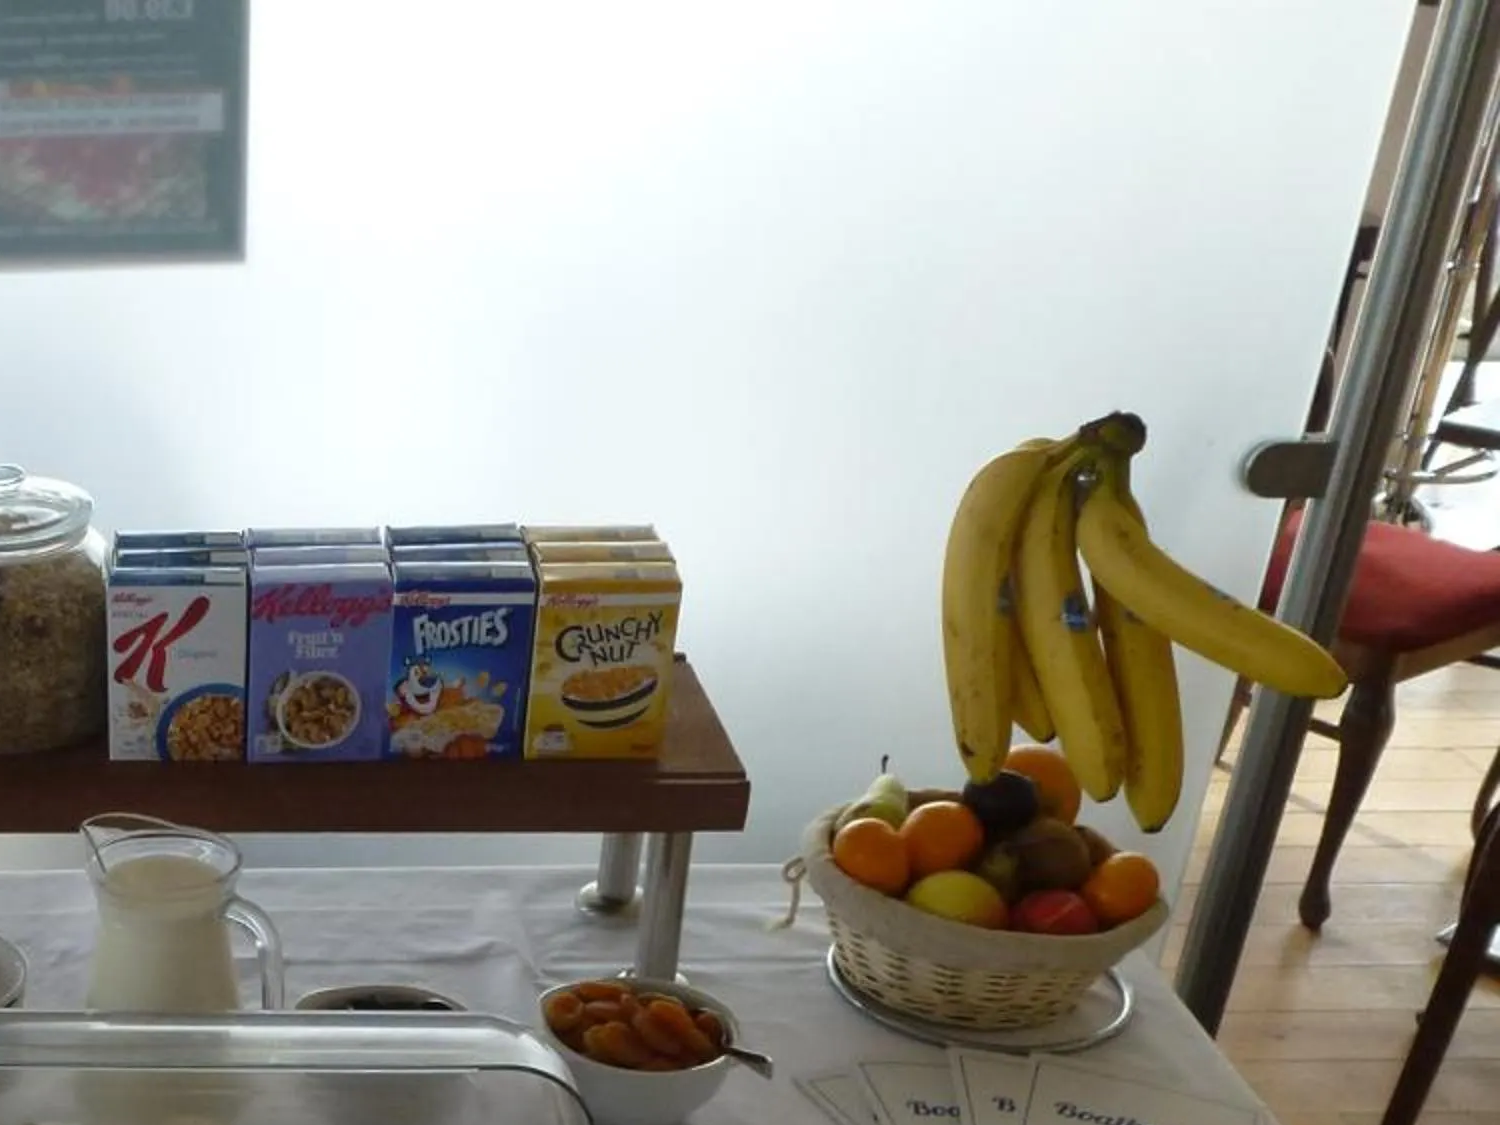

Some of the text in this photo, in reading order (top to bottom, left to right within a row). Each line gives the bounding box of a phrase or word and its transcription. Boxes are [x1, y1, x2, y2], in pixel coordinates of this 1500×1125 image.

[113, 595, 211, 692] K
[413, 608, 512, 655] FROSTIES
[555, 610, 663, 662] CRUNCHY
[589, 640, 641, 666] NUT
